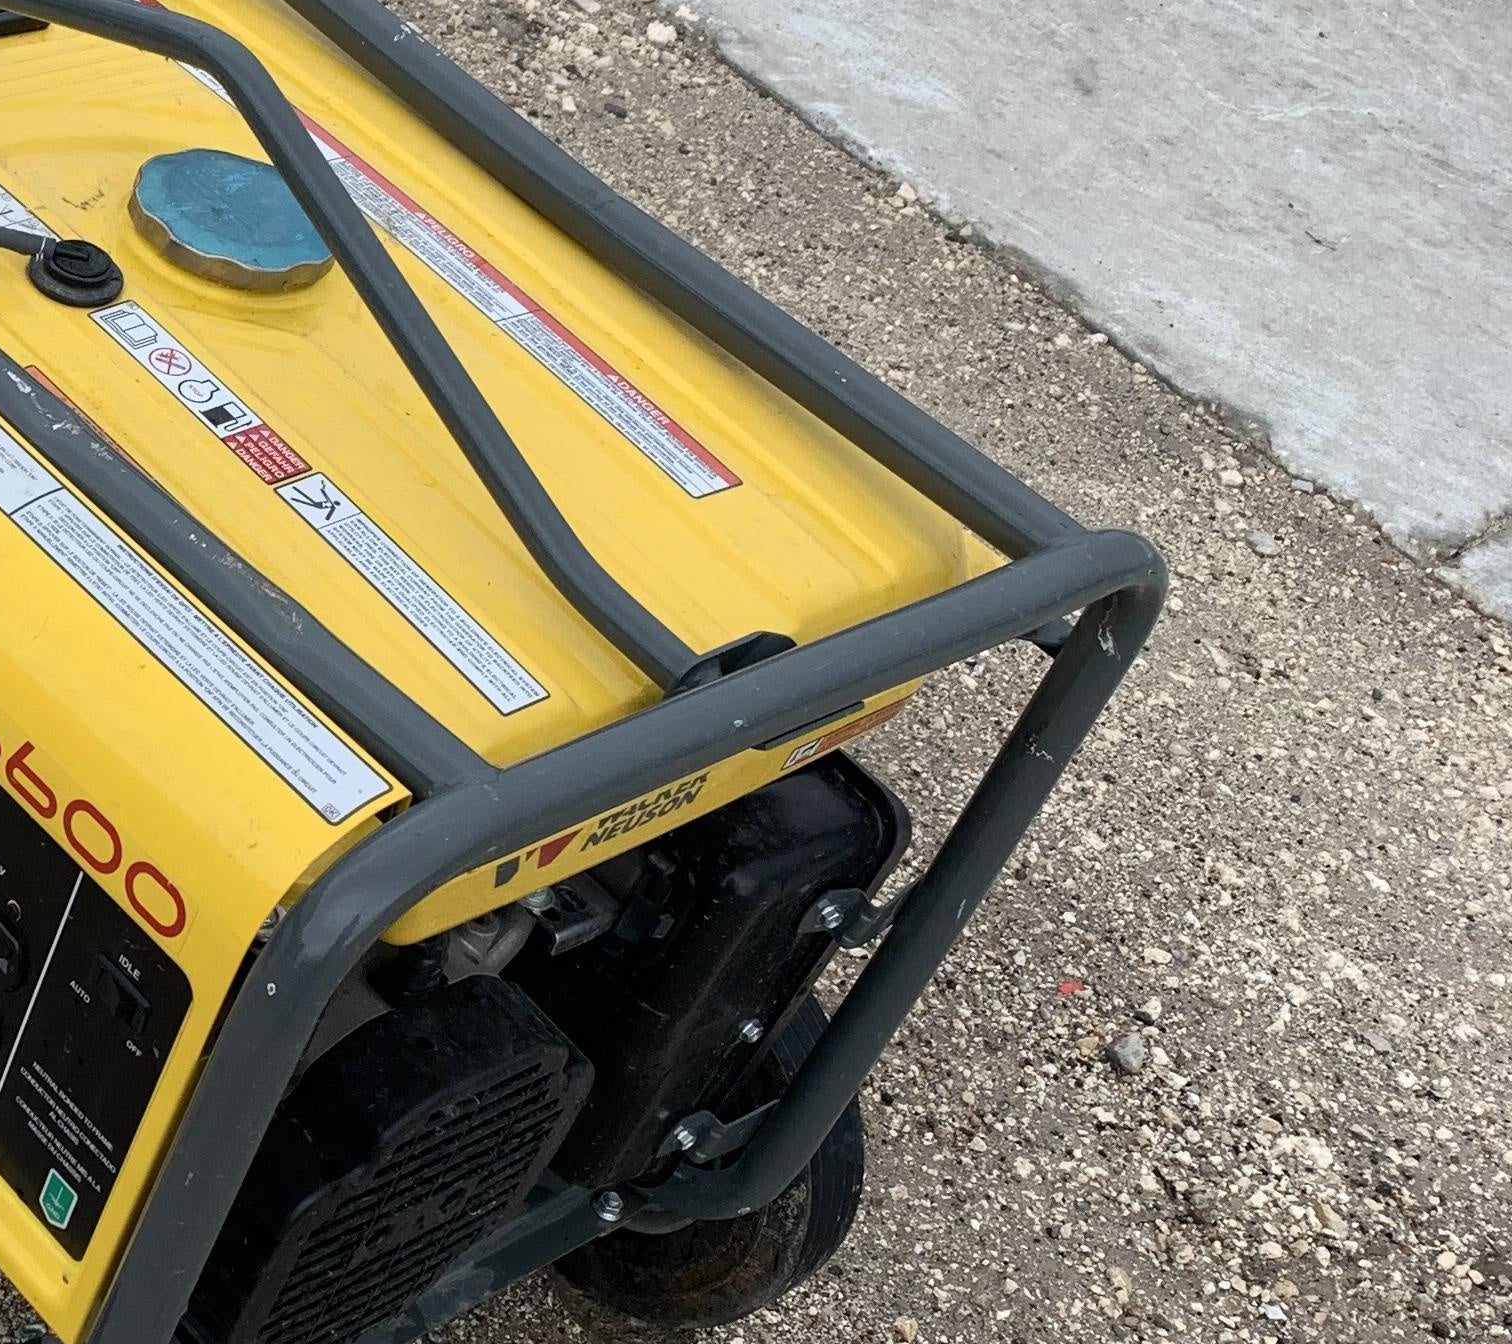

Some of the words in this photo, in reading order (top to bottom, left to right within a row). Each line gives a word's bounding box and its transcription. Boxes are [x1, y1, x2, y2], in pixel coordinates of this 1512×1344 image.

[423, 218, 476, 260] PELIGRO
[617, 379, 671, 426] DANGER
[236, 449, 274, 483] DANGER
[243, 442, 285, 480] PELIGRO
[259, 440, 294, 474] GEFAHR
[268, 437, 306, 470] DANGER
[579, 785, 704, 852] NEUSON
[118, 954, 141, 981] IDLE
[69, 980, 91, 1004] AUTO
[125, 1039, 143, 1057] OFF
